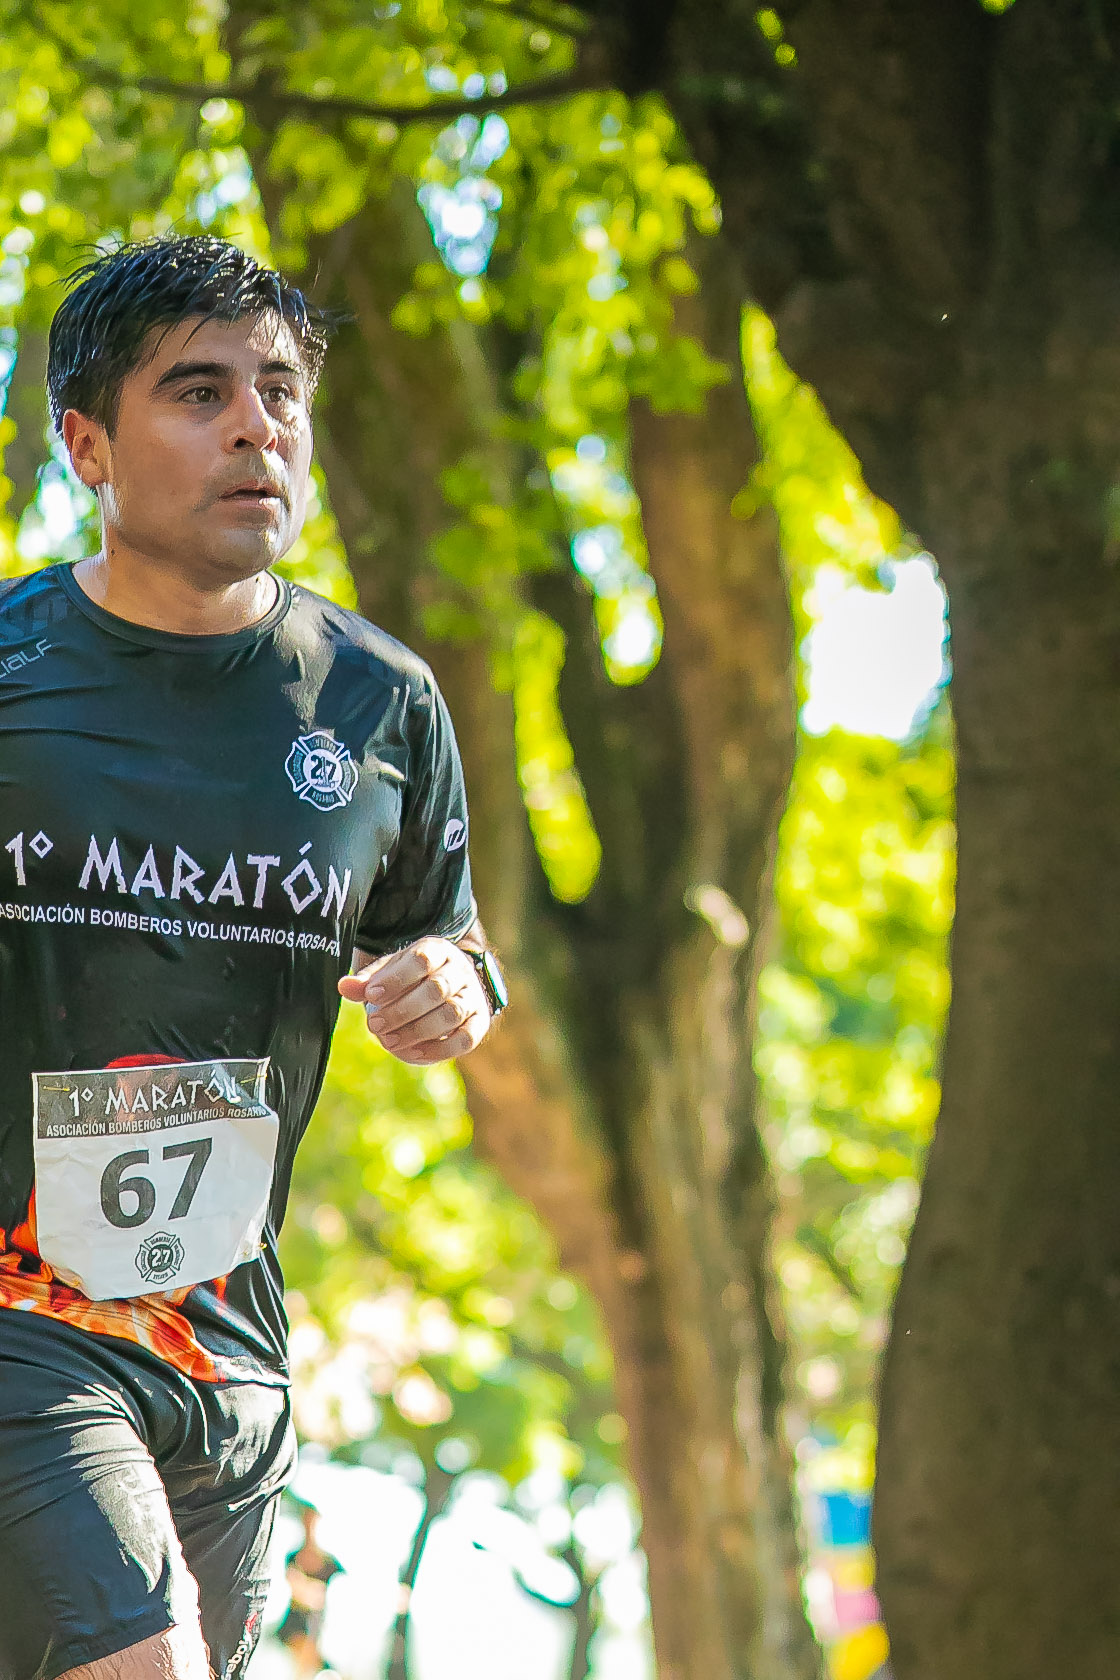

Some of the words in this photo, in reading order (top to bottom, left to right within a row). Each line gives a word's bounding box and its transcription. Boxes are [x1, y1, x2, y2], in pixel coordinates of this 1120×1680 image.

[310, 754, 337, 782] 27
[78, 834, 352, 918] MARATÓN
[90, 908, 183, 936] BOMBEROS
[187, 920, 295, 949] VOLUNTARIOS
[105, 1069, 238, 1114] MARATÓN
[46, 1120, 106, 1137] ASOCIACIÓN
[108, 1118, 162, 1134] BOMBEROS
[164, 1107, 225, 1128] VOLUNTARIOS
[100, 1137, 213, 1229] 67
[151, 1248, 171, 1269] 27
